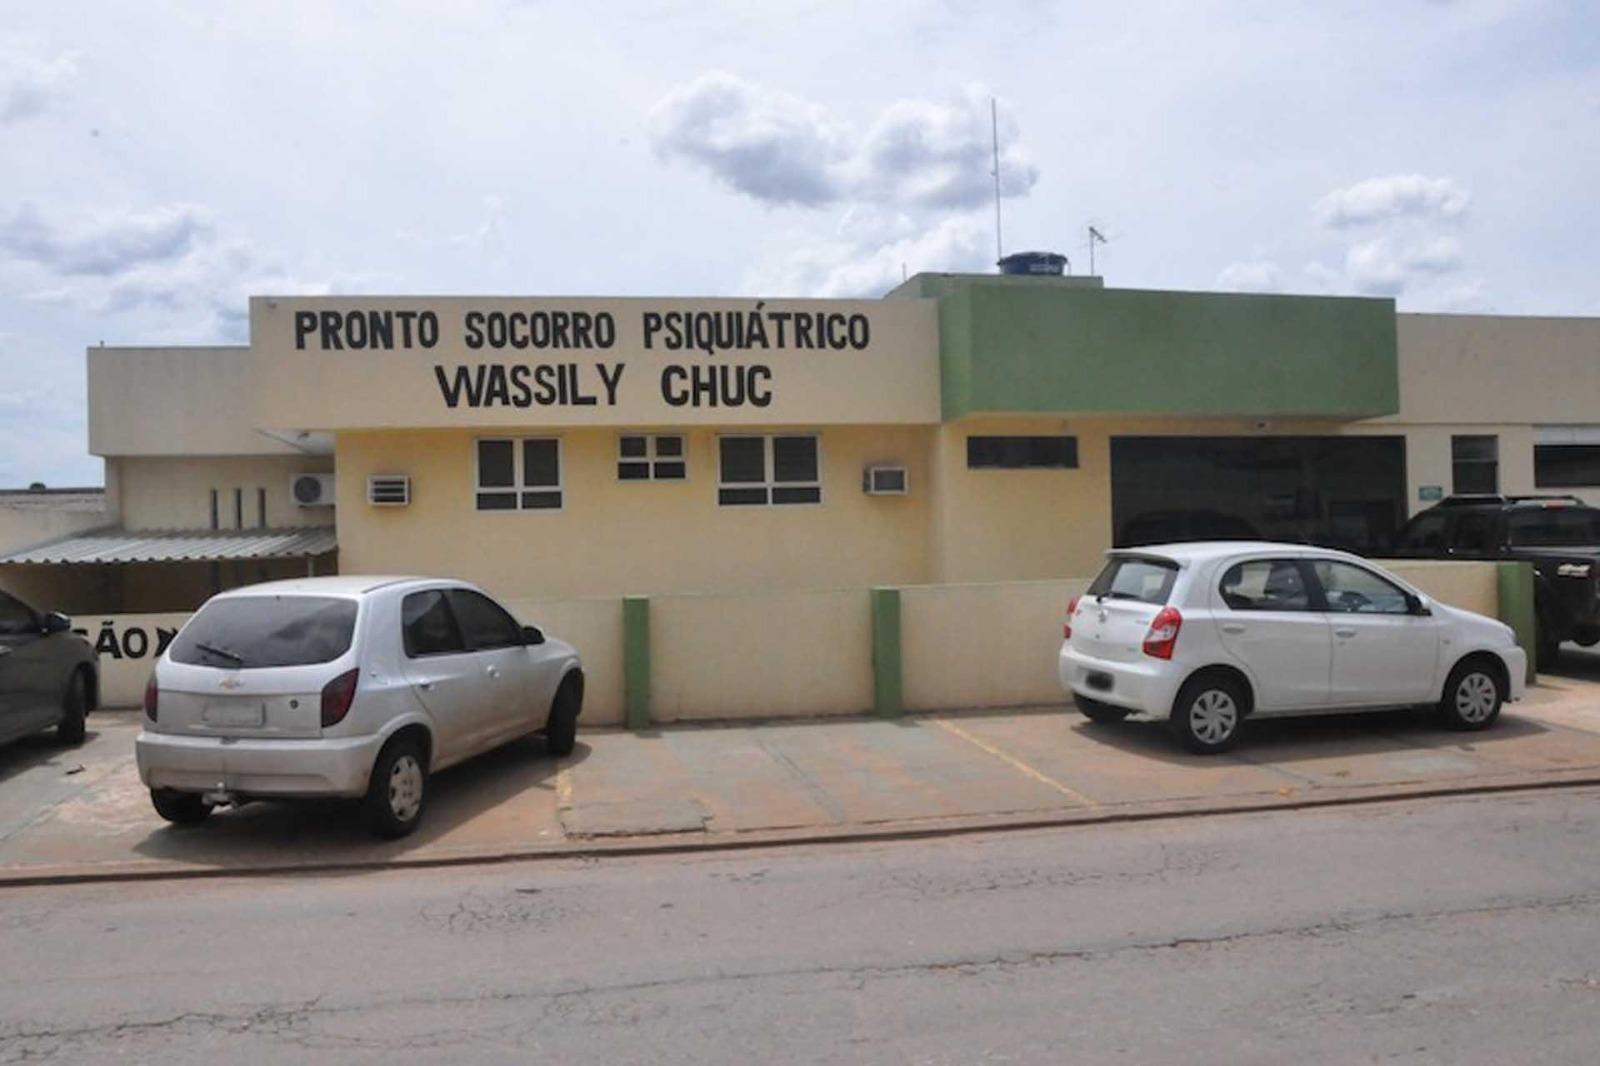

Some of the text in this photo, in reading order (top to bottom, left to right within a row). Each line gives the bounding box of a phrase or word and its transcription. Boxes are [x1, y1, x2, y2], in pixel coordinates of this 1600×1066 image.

[294, 300, 870, 356] PRONTO SOCORRO PSIQUIÁTRICO
[434, 363, 772, 408] WASSILY CHUC
[73, 621, 149, 659] ÃO
